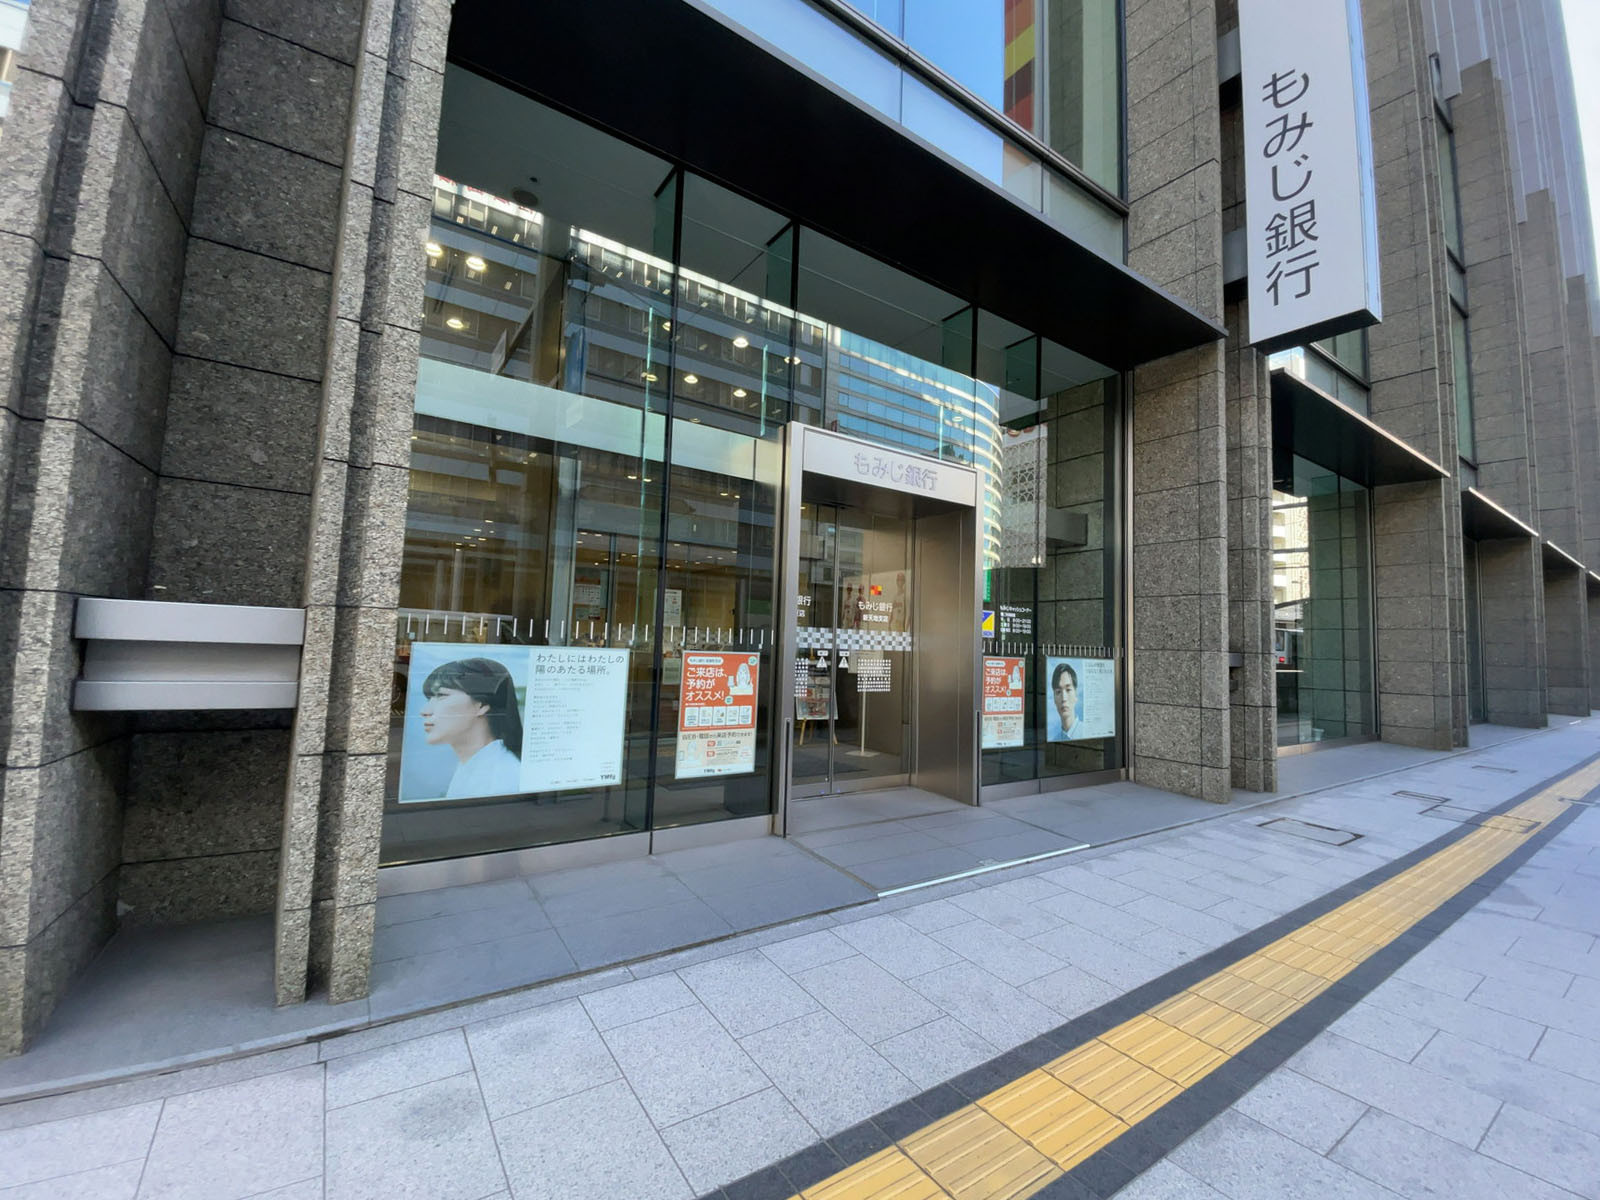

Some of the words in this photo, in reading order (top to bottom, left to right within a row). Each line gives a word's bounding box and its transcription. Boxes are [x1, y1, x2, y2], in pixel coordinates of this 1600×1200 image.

[1262, 68, 1320, 306] もみじ銀行
[854, 452, 938, 491] もみじ銀行
[858, 601, 893, 612] もみじ銀行
[536, 654, 625, 664] わたしにはわたしの
[535, 664, 610, 675] 陽のあたる場所。
[686, 667, 727, 678] ご来店は、
[686, 679, 716, 690] 予約が
